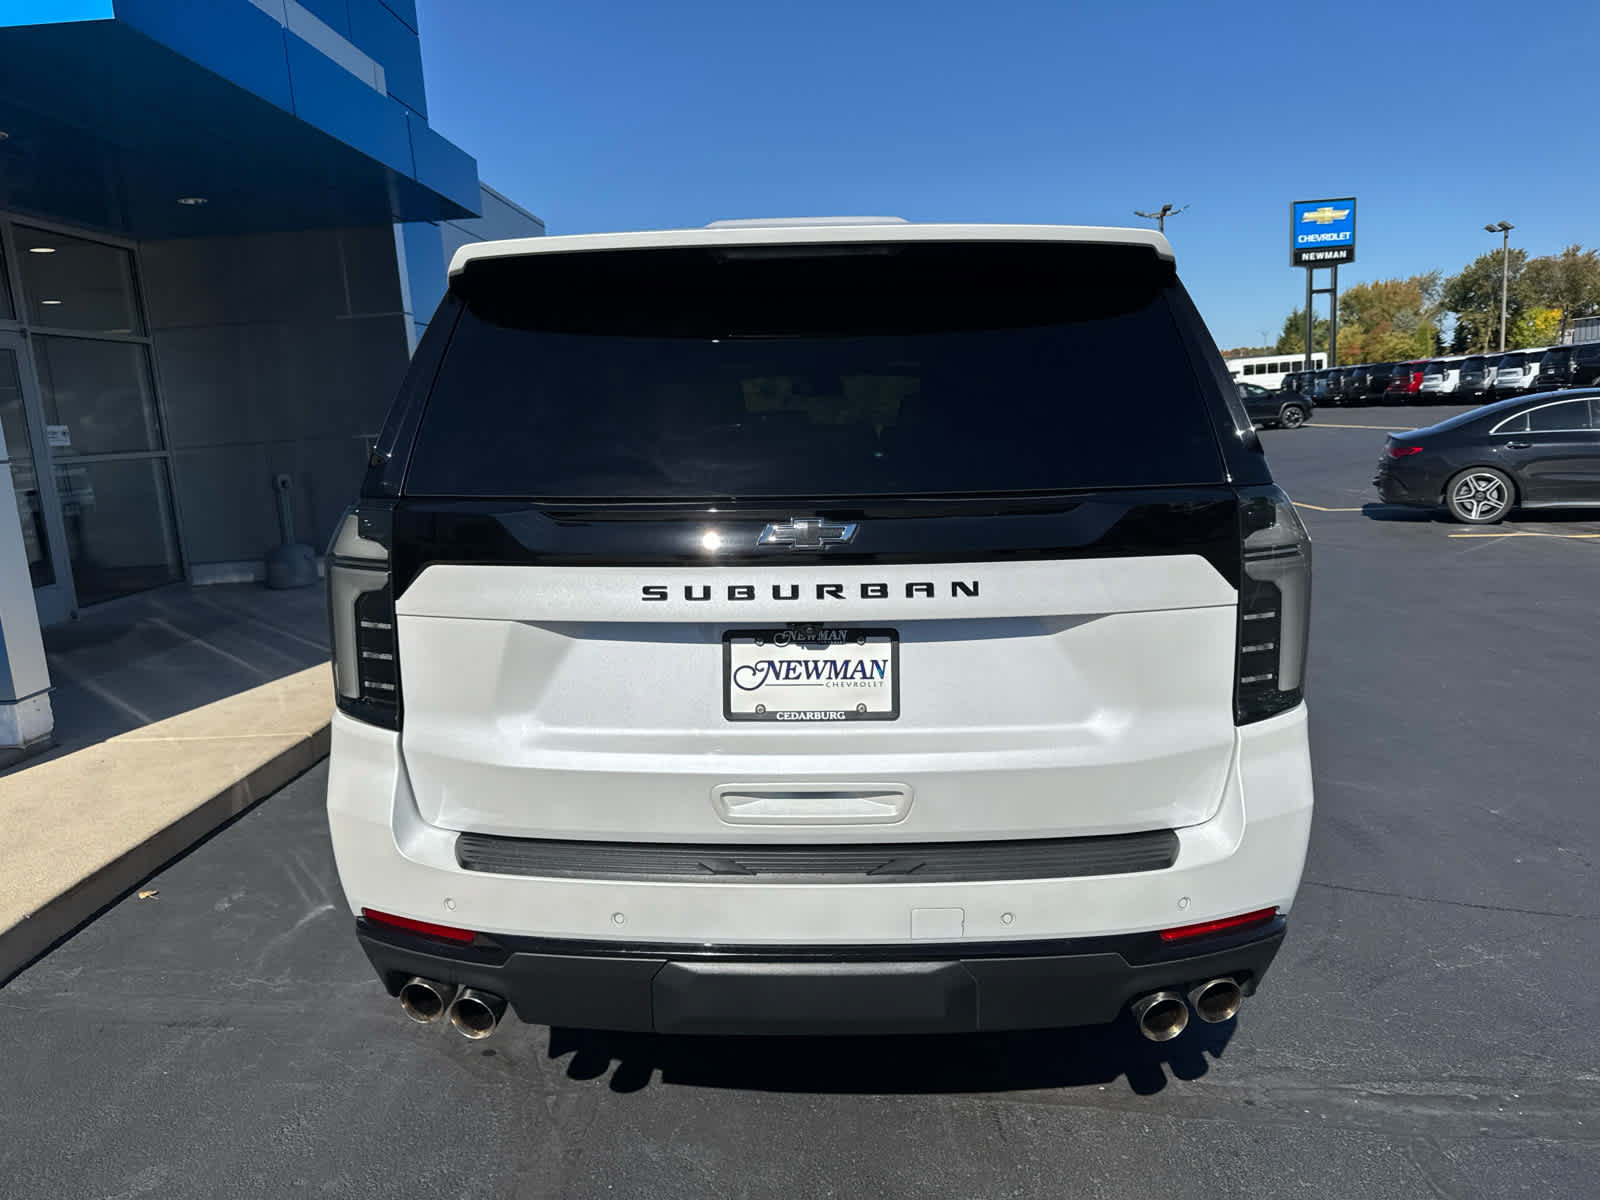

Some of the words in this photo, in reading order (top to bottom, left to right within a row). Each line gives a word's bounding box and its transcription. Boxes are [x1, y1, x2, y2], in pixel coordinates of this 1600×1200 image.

[1298, 231, 1352, 243] CHEVROLET
[1301, 250, 1347, 260] NEWMAN
[641, 581, 979, 601] SUBURBAN
[733, 659, 888, 691] NEWMAN
[776, 712, 845, 720] CEDARBURG
